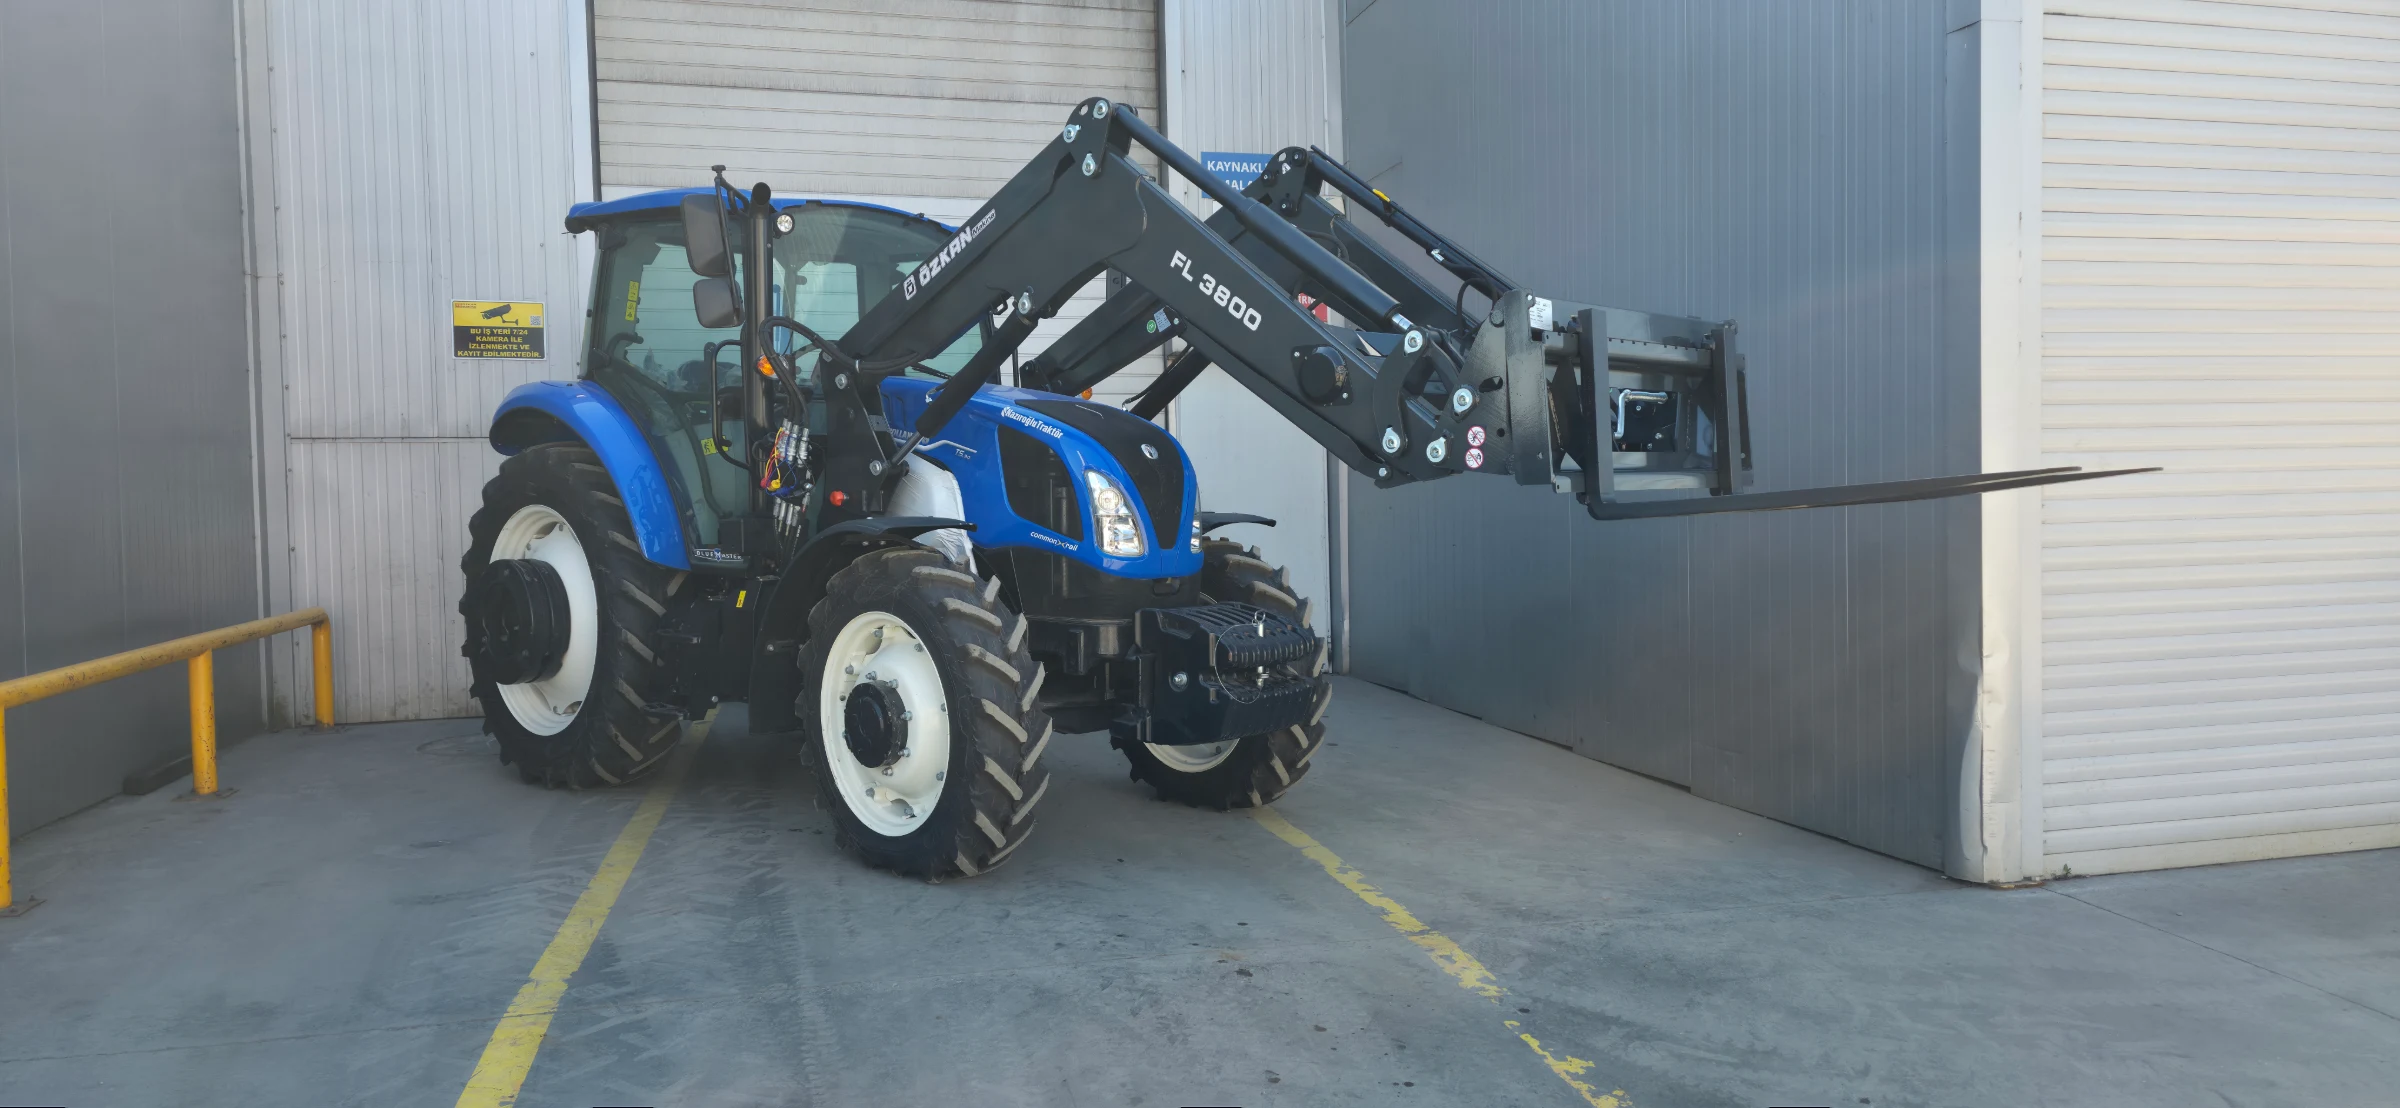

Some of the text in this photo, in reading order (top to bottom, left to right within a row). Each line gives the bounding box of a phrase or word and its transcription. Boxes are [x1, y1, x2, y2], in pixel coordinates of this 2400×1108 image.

[1207, 160, 1268, 173] KAYNAKL
[919, 226, 973, 288] ÖZKAN
[1170, 250, 1194, 282] FL
[1199, 273, 1262, 332] 3800
[469, 342, 518, 350] İZLENMEKTE
